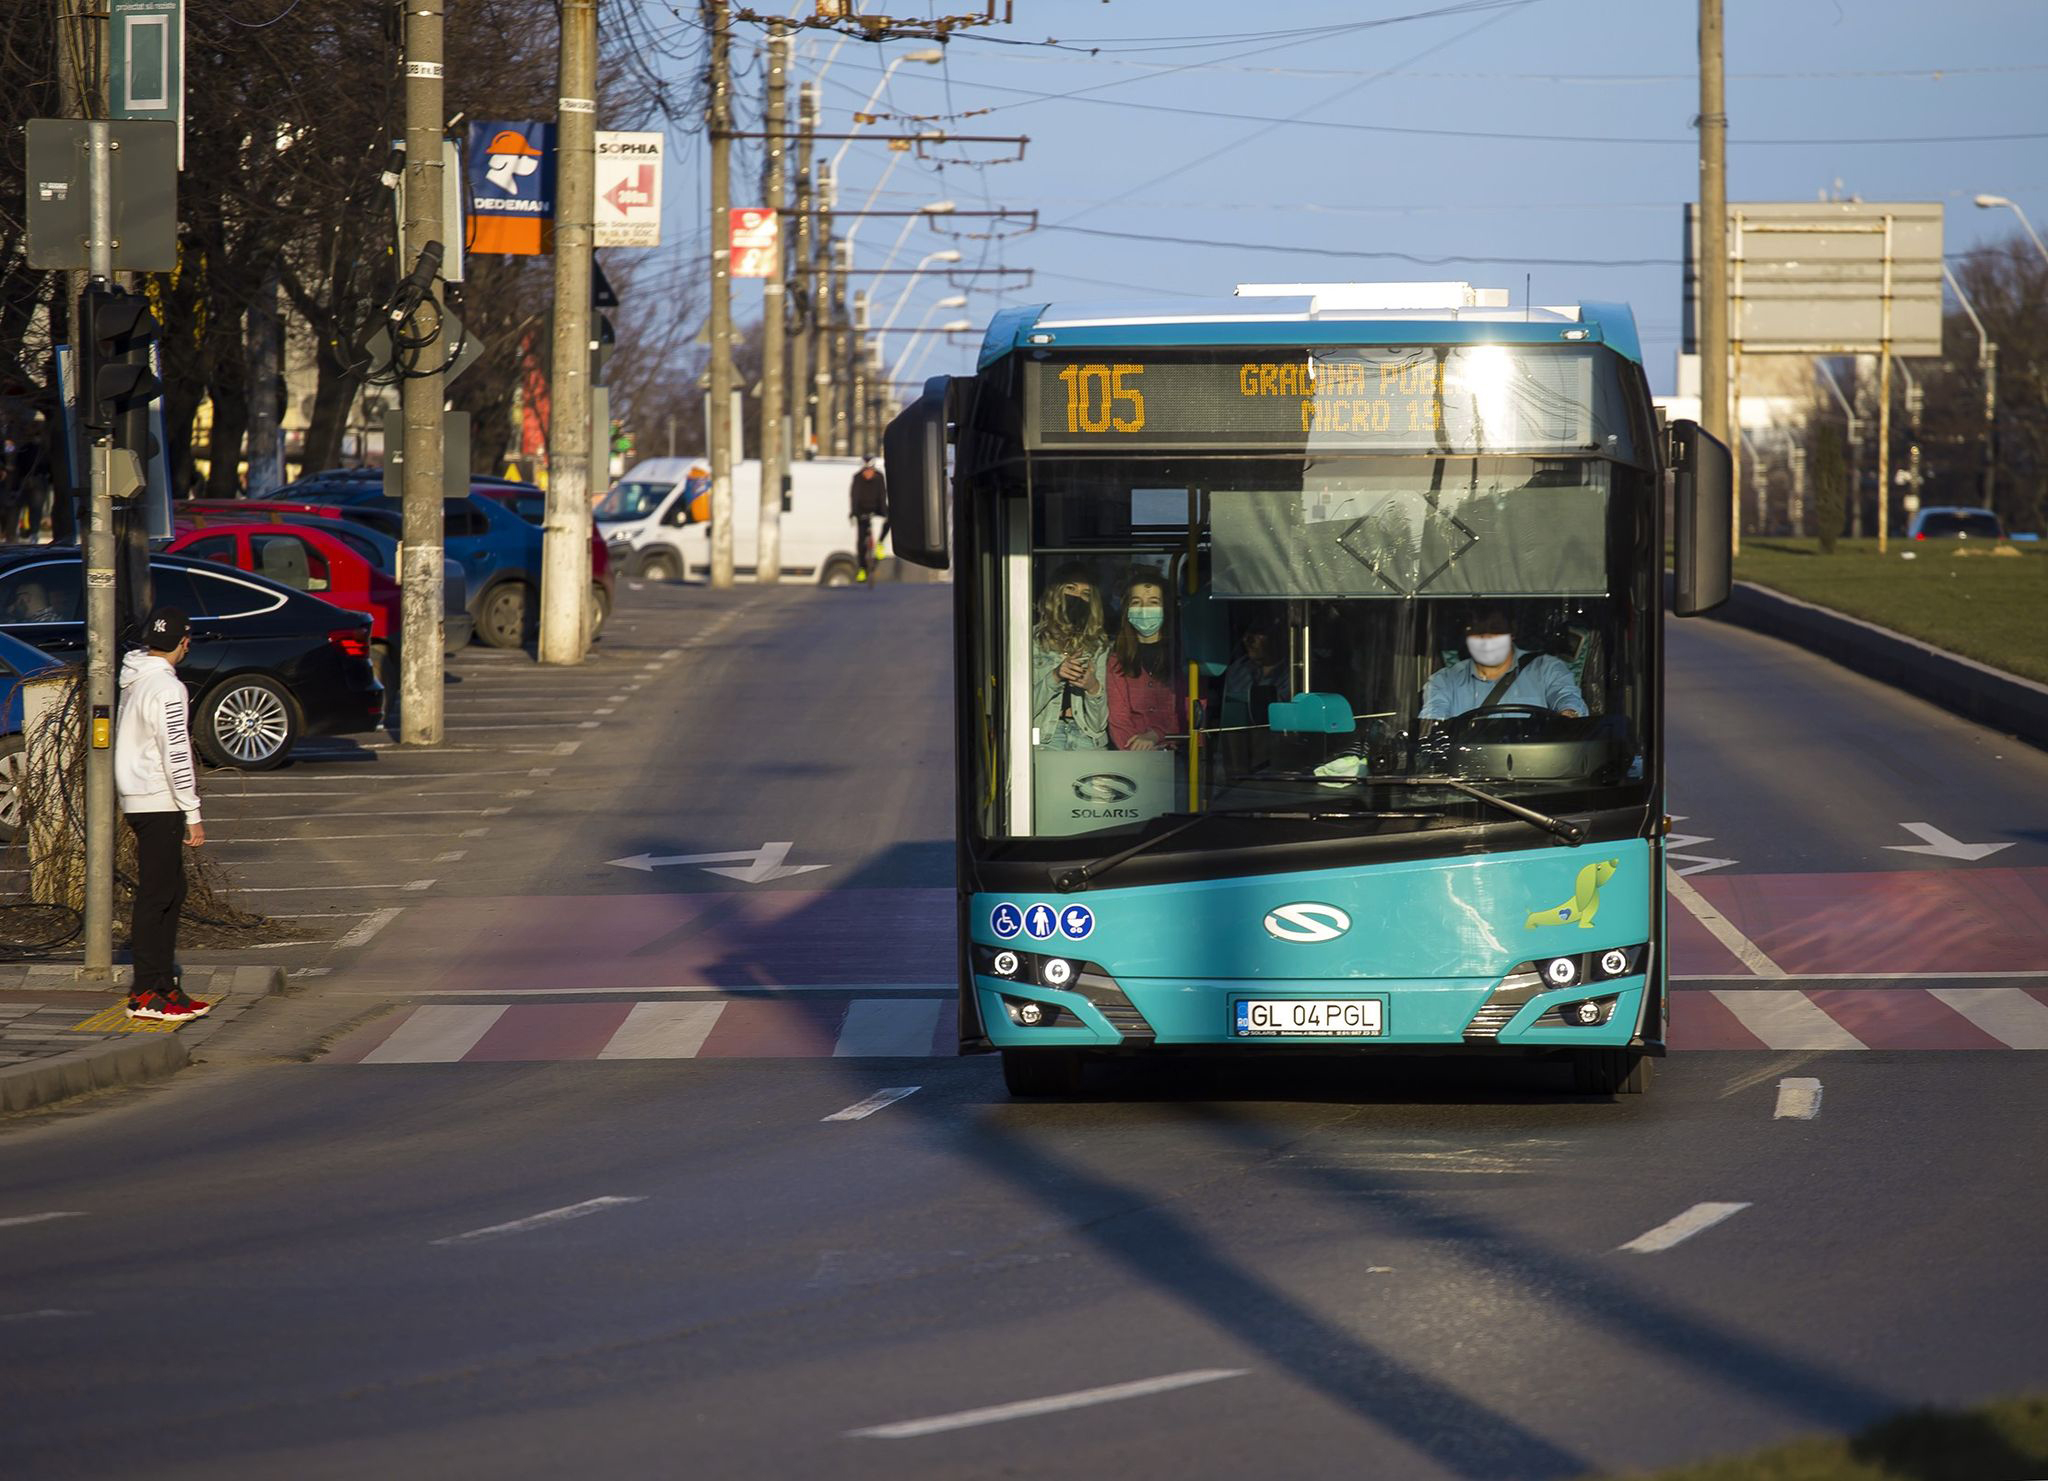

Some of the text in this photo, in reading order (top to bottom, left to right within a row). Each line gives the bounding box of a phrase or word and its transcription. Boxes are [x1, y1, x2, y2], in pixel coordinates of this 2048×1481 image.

[598, 143, 658, 154] SOPHIA
[474, 197, 550, 212] DEDEMAN
[1239, 363, 1366, 396] GRADINA
[1059, 364, 1145, 433] 105
[1301, 399, 1441, 432] MICRO 19
[164, 701, 193, 791] CITY OF ASPHALT
[1071, 808, 1140, 819] SOLARIS
[1251, 1005, 1374, 1027] GL 04 PGL
